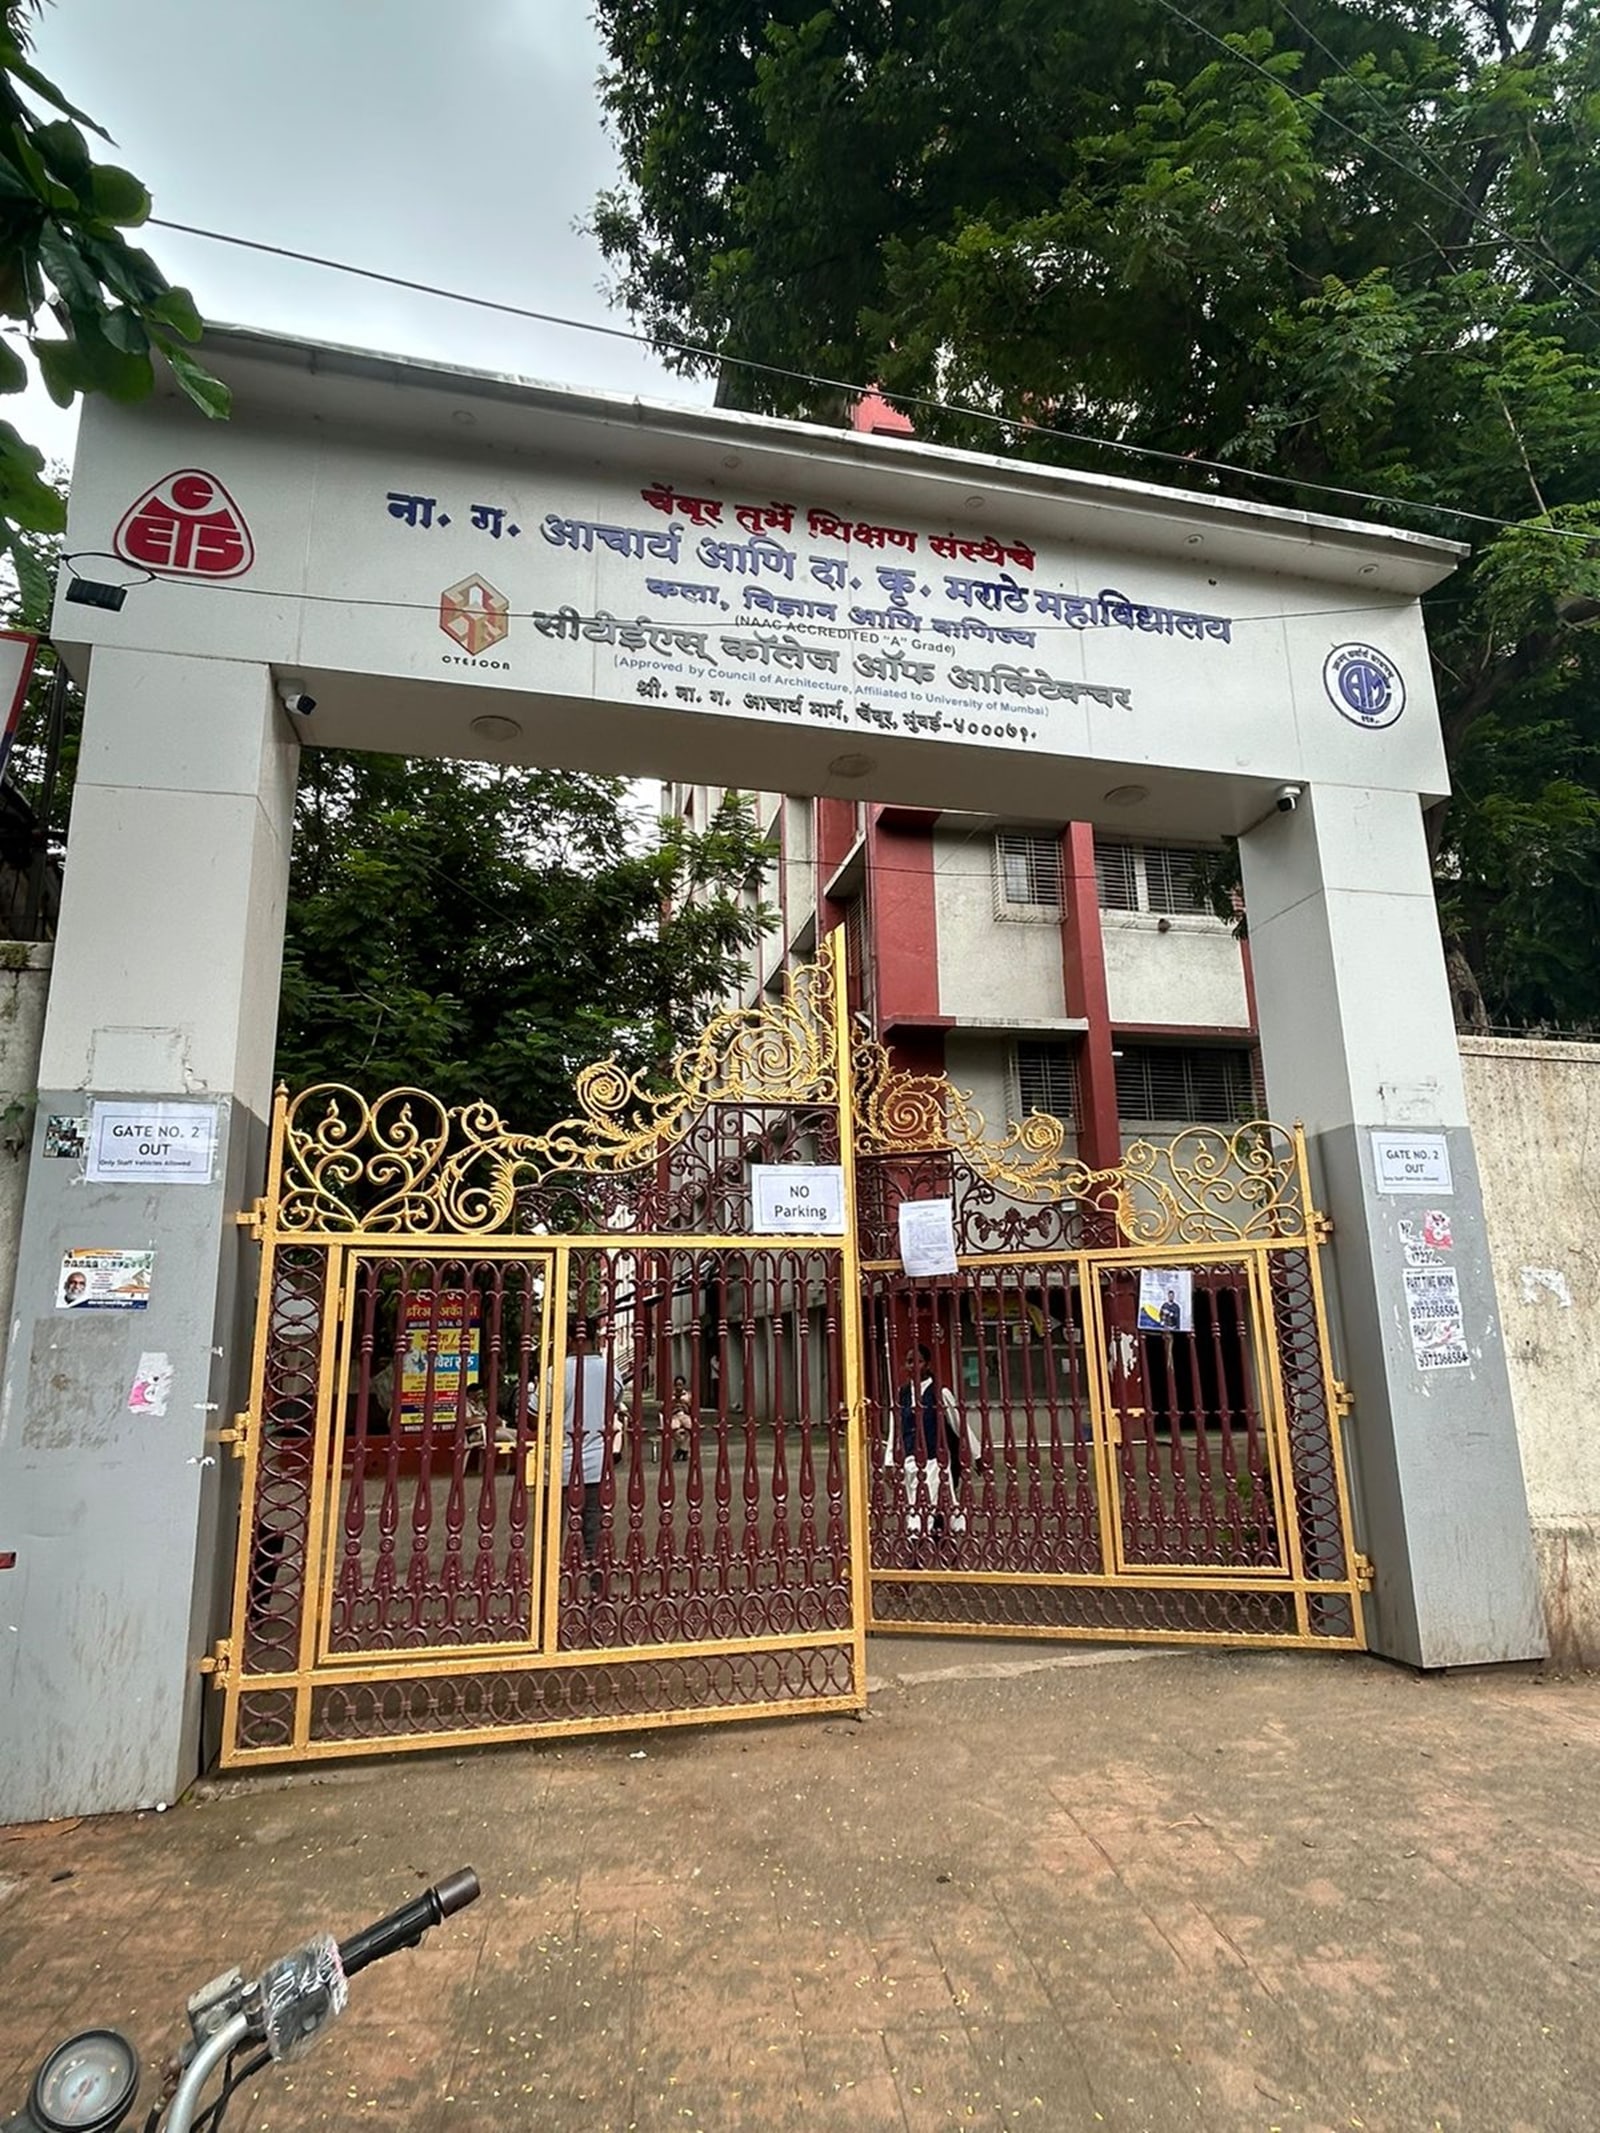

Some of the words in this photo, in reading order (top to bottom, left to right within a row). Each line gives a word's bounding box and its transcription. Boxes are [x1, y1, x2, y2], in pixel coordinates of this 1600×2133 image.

[641, 482, 723, 529] चेंबूर
[735, 501, 797, 536] तुर्भे
[807, 508, 918, 553] शिक्षण
[928, 532, 1036, 571] संस्थेचे
[386, 492, 451, 528] ना.
[471, 504, 521, 539] ग.
[541, 514, 685, 564] आचार्य
[696, 536, 796, 580] आणि
[809, 556, 863, 591] दा.
[876, 566, 932, 607] कृ.
[944, 573, 1029, 613] मराठे
[1034, 589, 1233, 644] महाविद्यालय
[645, 577, 730, 611] कला,
[743, 583, 838, 621] विज्ञान
[848, 605, 923, 634] आणि
[931, 616, 1037, 648] वाणिज्य
[735, 615, 782, 630] (NAAC
[787, 620, 880, 644] ACCREDITED
[912, 639, 956, 656] Grade)
[614, 655, 683, 674] (Approved
[689, 664, 705, 679] by
[708, 666, 757, 683] Council
[759, 674, 773, 684] of
[774, 676, 853, 695] Architecture,
[855, 685, 908, 700] Affiliated
[910, 690, 923, 701] to
[925, 694, 983, 712] University
[986, 701, 999, 711] of
[1000, 703, 1049, 718] Mumbai)
[721, 630, 840, 674] कॉलेज
[853, 648, 935, 685] ऑफ
[948, 663, 1133, 712] आर्किटेक्चर
[637, 676, 667, 699] श्री.
[710, 689, 731, 707] ग.
[743, 692, 804, 716] आचार्य
[112, 1124, 152, 1138] GATE
[158, 1126, 185, 1138] NO.
[191, 1126, 200, 1138] 2
[138, 1143, 171, 1156] OUT
[1386, 1149, 1411, 1160] GATE
[1413, 1150, 1431, 1160] NO.
[1432, 1150, 1439, 1160] 2
[1405, 1163, 1424, 1173] OUT
[789, 1185, 810, 1198] NO
[774, 1205, 828, 1221] Parking
